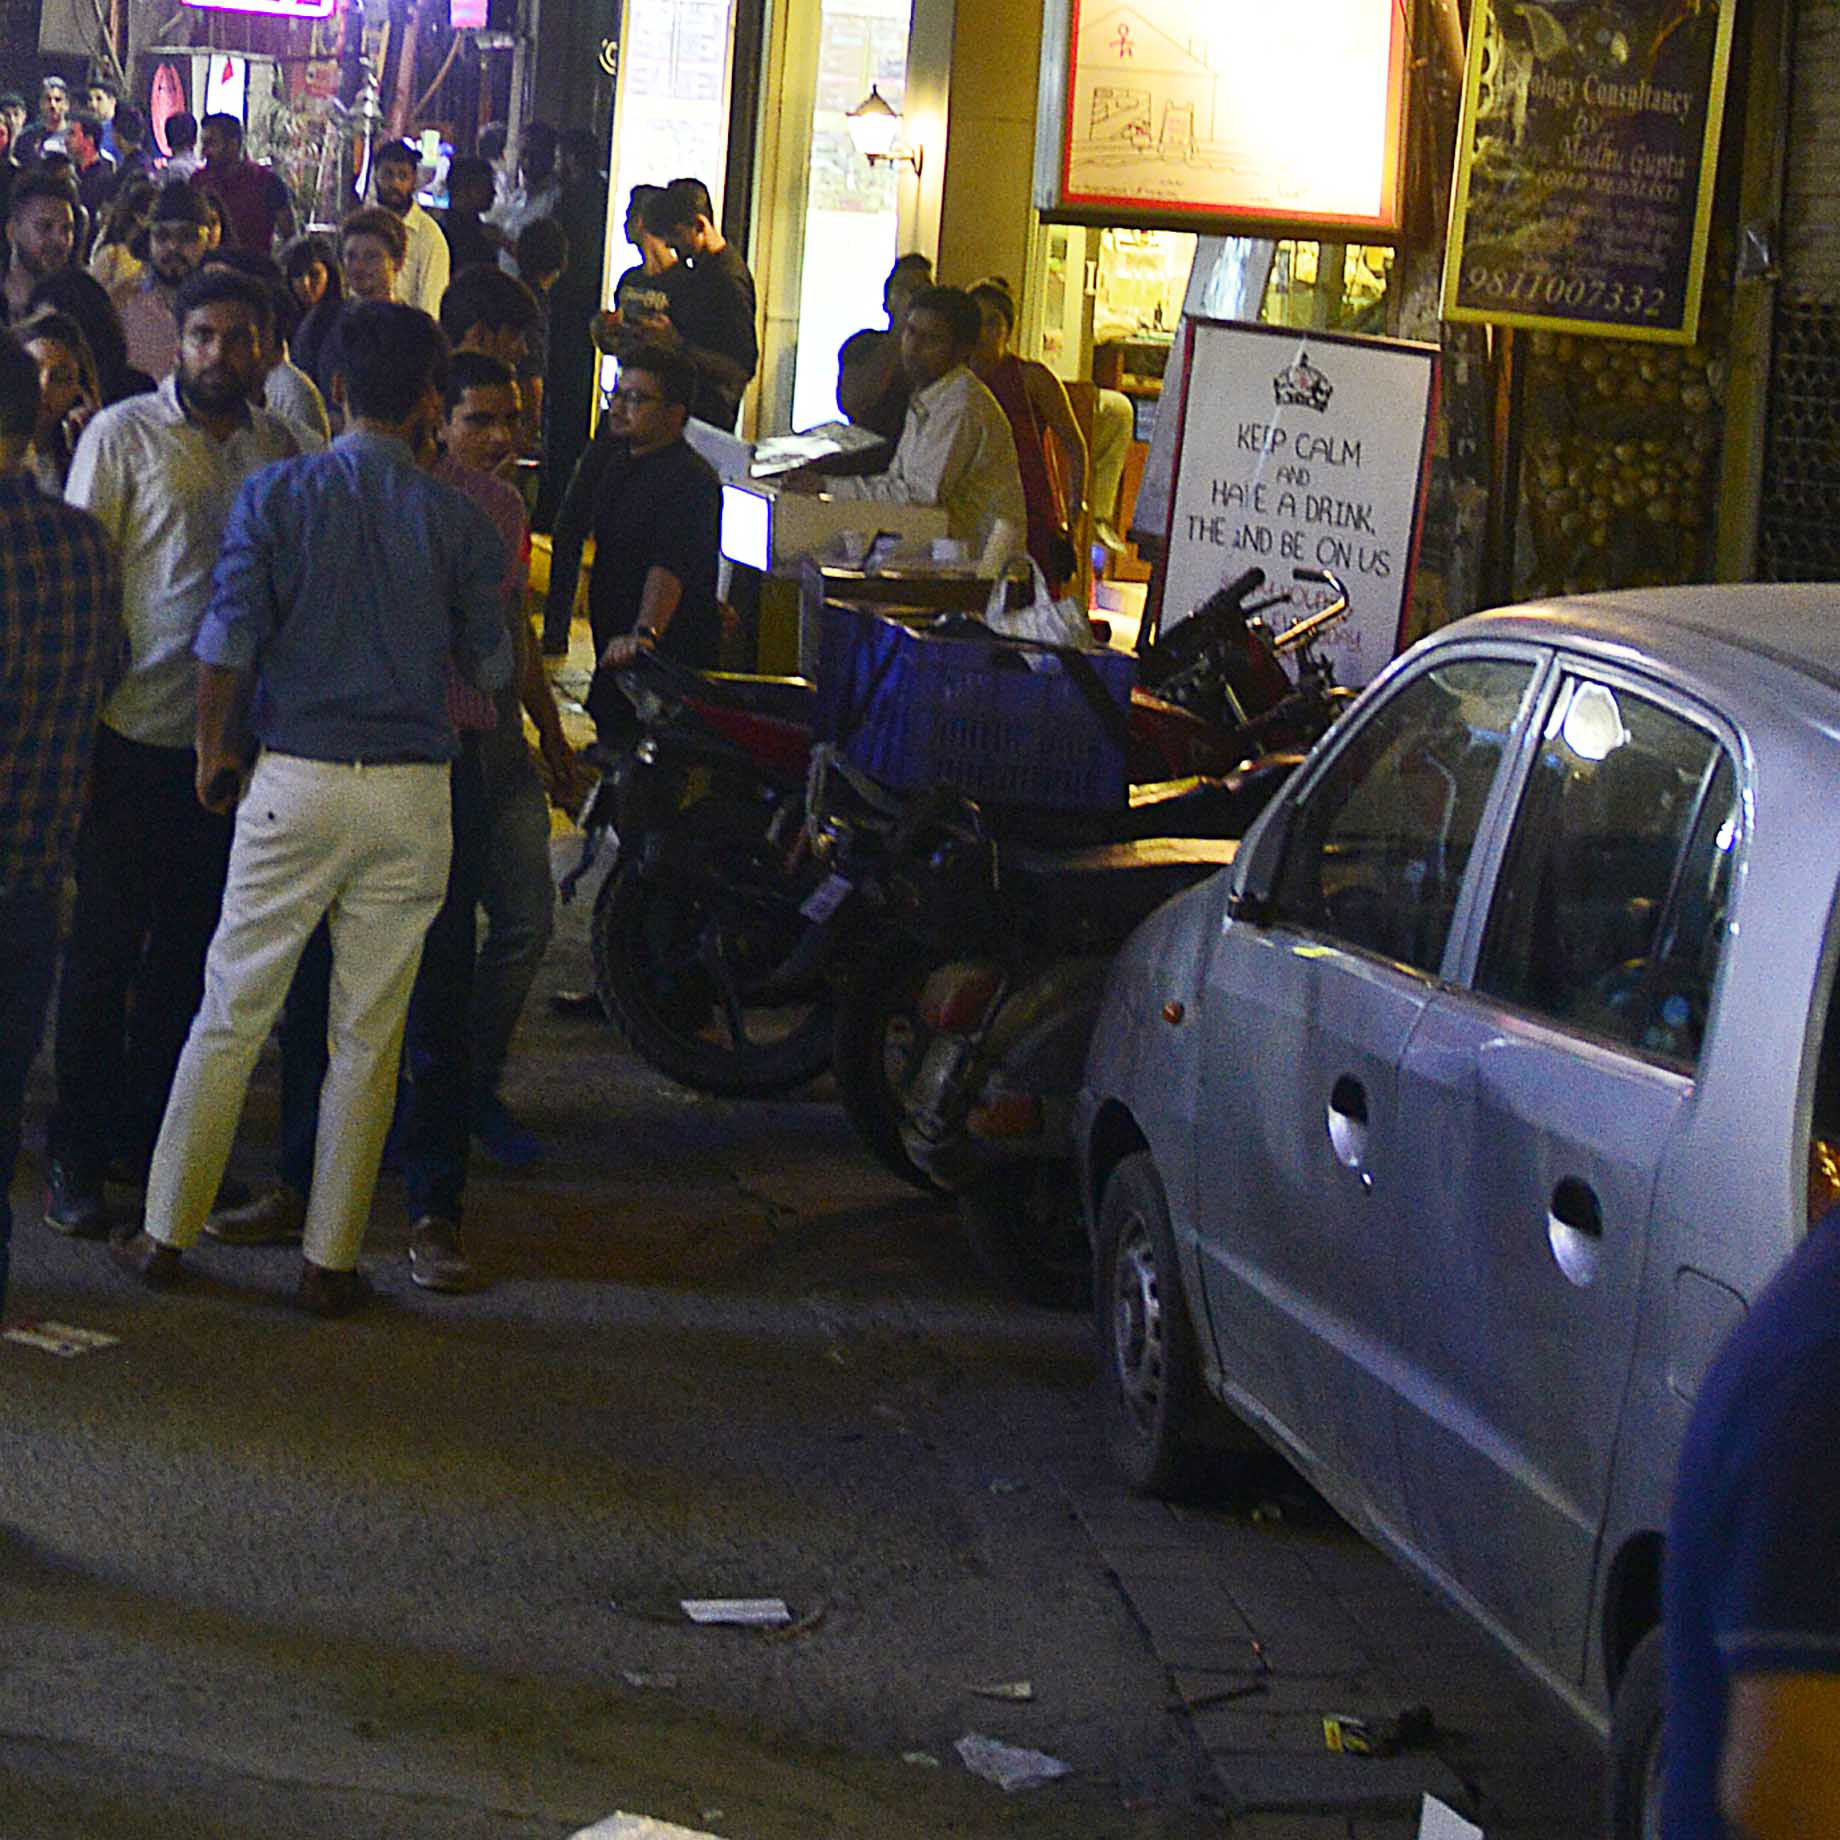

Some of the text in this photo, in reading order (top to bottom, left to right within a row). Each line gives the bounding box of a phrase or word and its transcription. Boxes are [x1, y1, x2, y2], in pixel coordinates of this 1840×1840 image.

[1295, 432, 1361, 467] CALM
[1278, 464, 1310, 486] AND
[1278, 493, 1296, 517] A
[1186, 514, 1225, 546] THE
[1281, 532, 1304, 557] BE
[1316, 536, 1352, 567] ON
[1360, 547, 1390, 577] US
